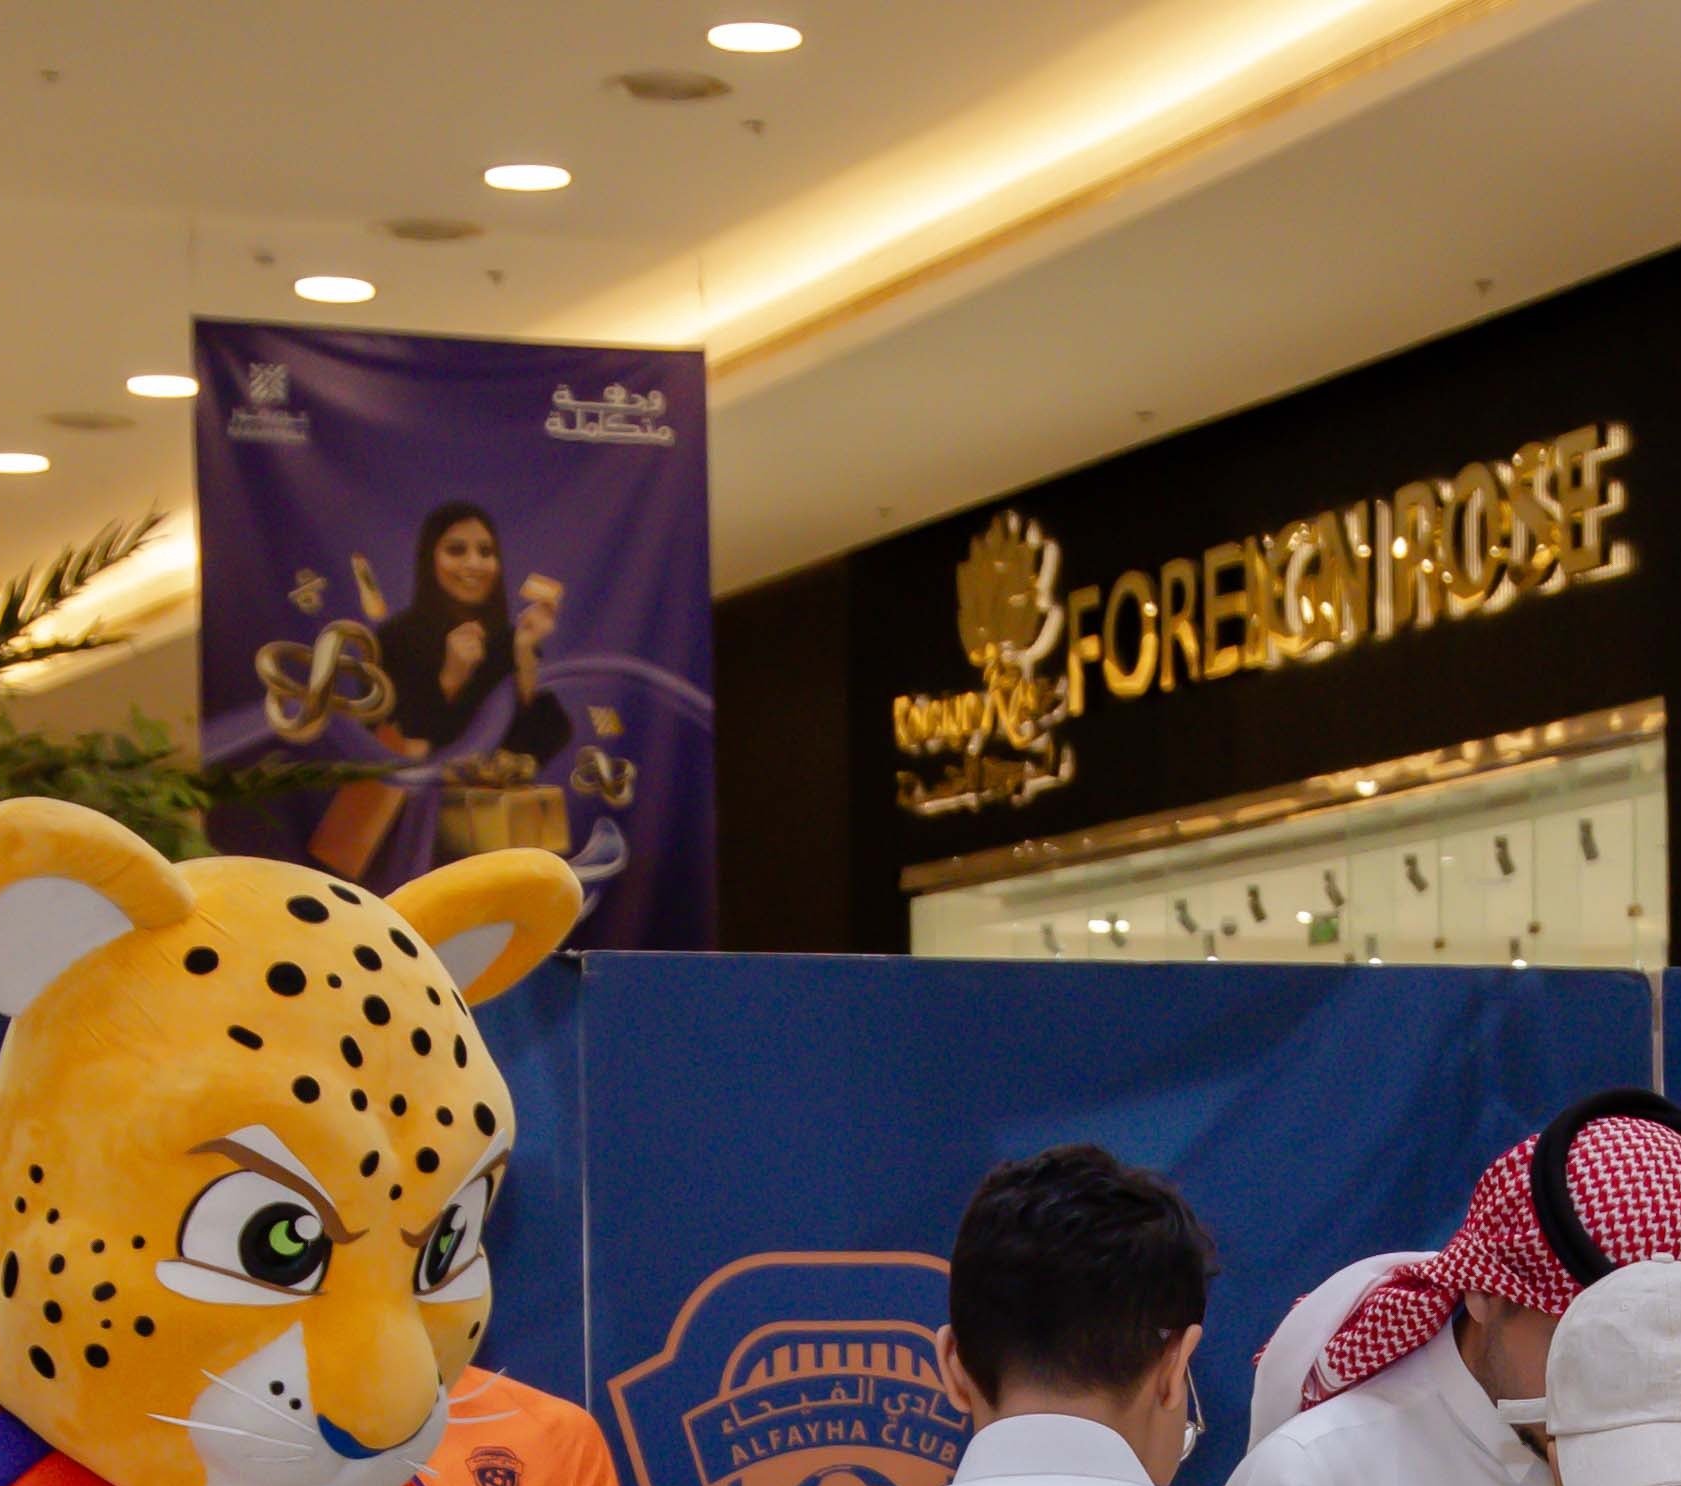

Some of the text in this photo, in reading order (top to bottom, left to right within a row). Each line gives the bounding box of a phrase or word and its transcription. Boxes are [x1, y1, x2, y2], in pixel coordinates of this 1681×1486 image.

[1066, 422, 1638, 718] FOREIGN ROSE
[721, 1376, 875, 1435] الفيحاء
[730, 1420, 959, 1467] ALFAYHA CLUB
